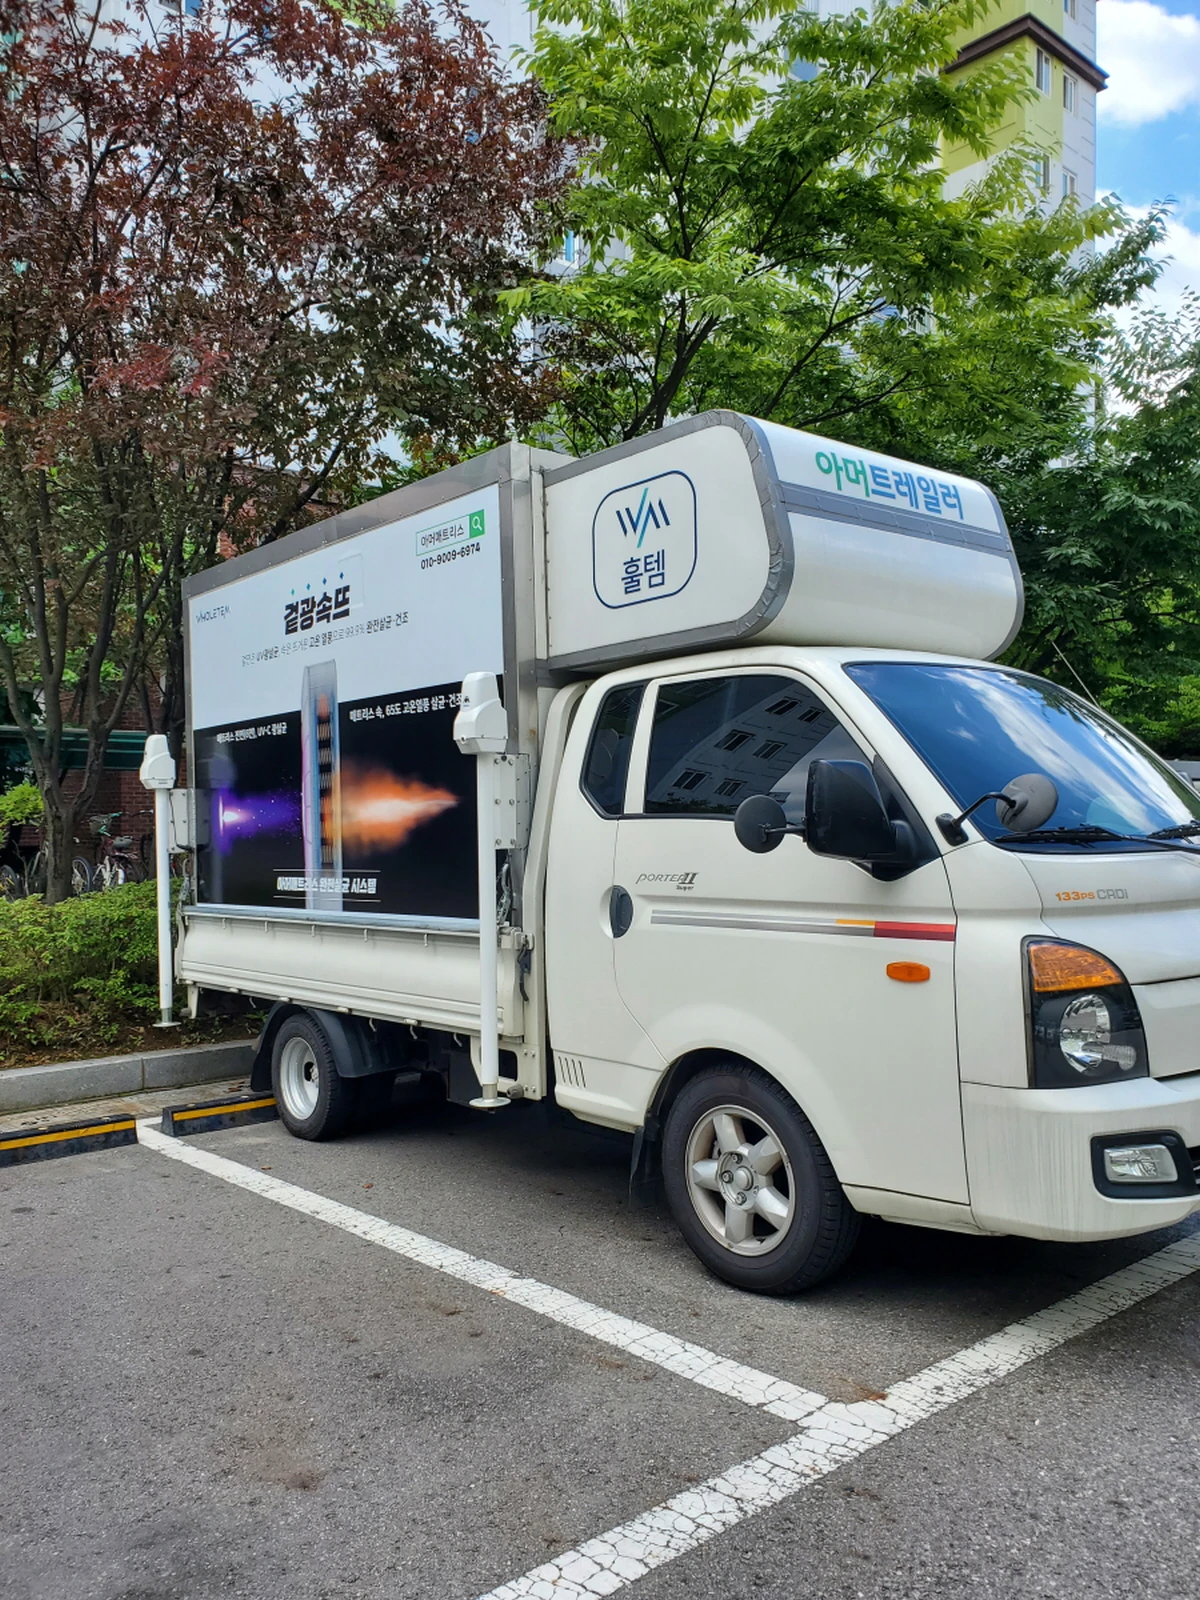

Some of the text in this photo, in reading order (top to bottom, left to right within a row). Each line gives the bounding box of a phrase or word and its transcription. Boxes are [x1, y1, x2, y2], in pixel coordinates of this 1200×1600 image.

[815, 451, 965, 520] 아머트레일러
[420, 524, 464, 548] 아머매트리스
[420, 541, 481, 570] 010-9009-6974
[621, 548, 666, 595] 훌템
[283, 584, 350, 636] 겉광속뜨
[385, 702, 402, 717] 65도
[350, 877, 377, 894] 시스템
